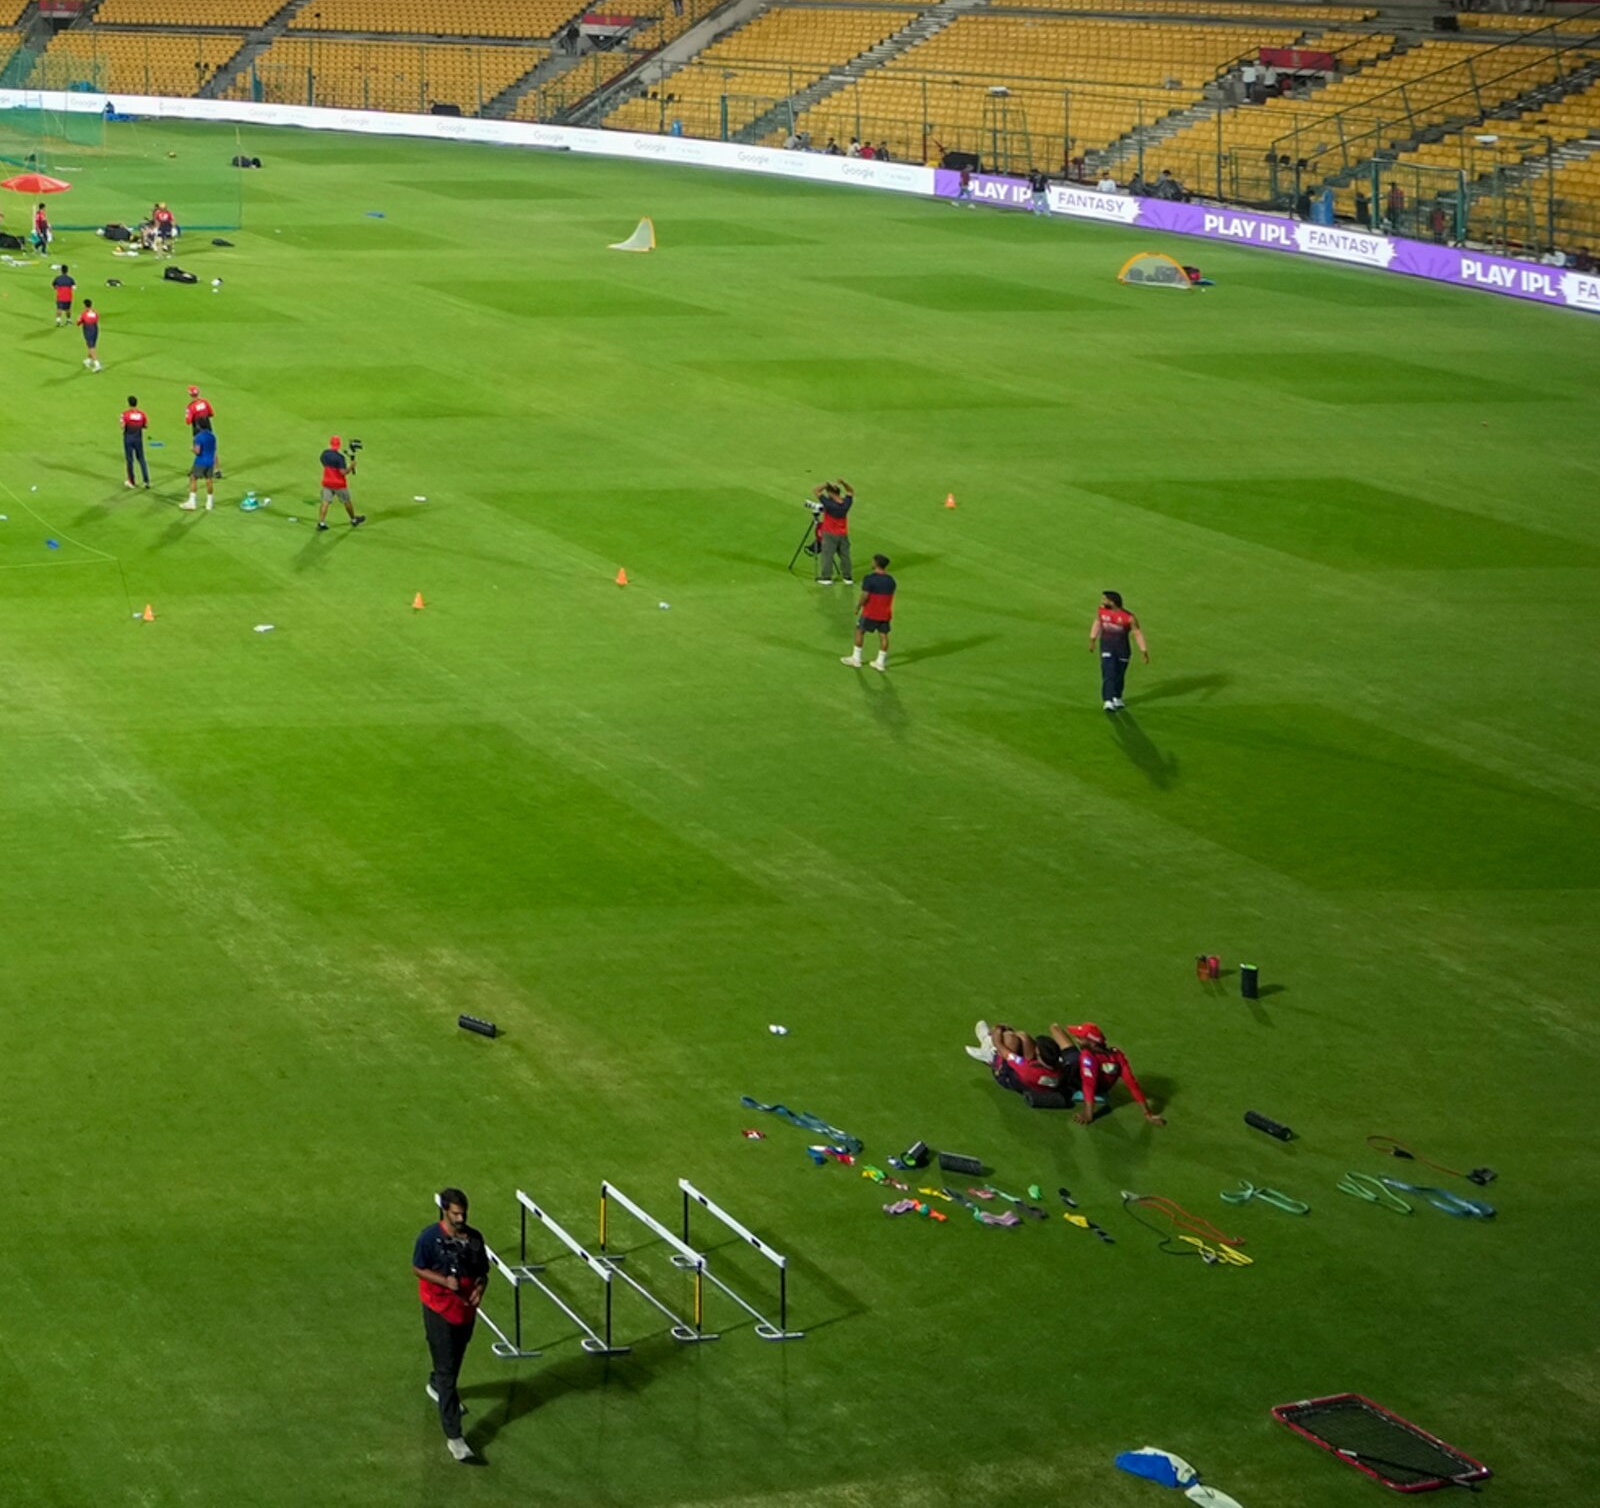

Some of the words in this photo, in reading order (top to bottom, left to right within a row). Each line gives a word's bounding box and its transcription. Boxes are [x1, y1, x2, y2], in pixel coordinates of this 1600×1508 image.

[737, 150, 770, 166] Google
[841, 163, 875, 180] Google
[1013, 184, 1035, 203] IP
[1058, 194, 1126, 213] FANTASY
[1204, 214, 1256, 239] PLAY
[1260, 222, 1292, 245] IPL
[1308, 230, 1380, 255] FANTASY
[1461, 258, 1517, 284] PLAY
[1521, 271, 1557, 296] IPL
